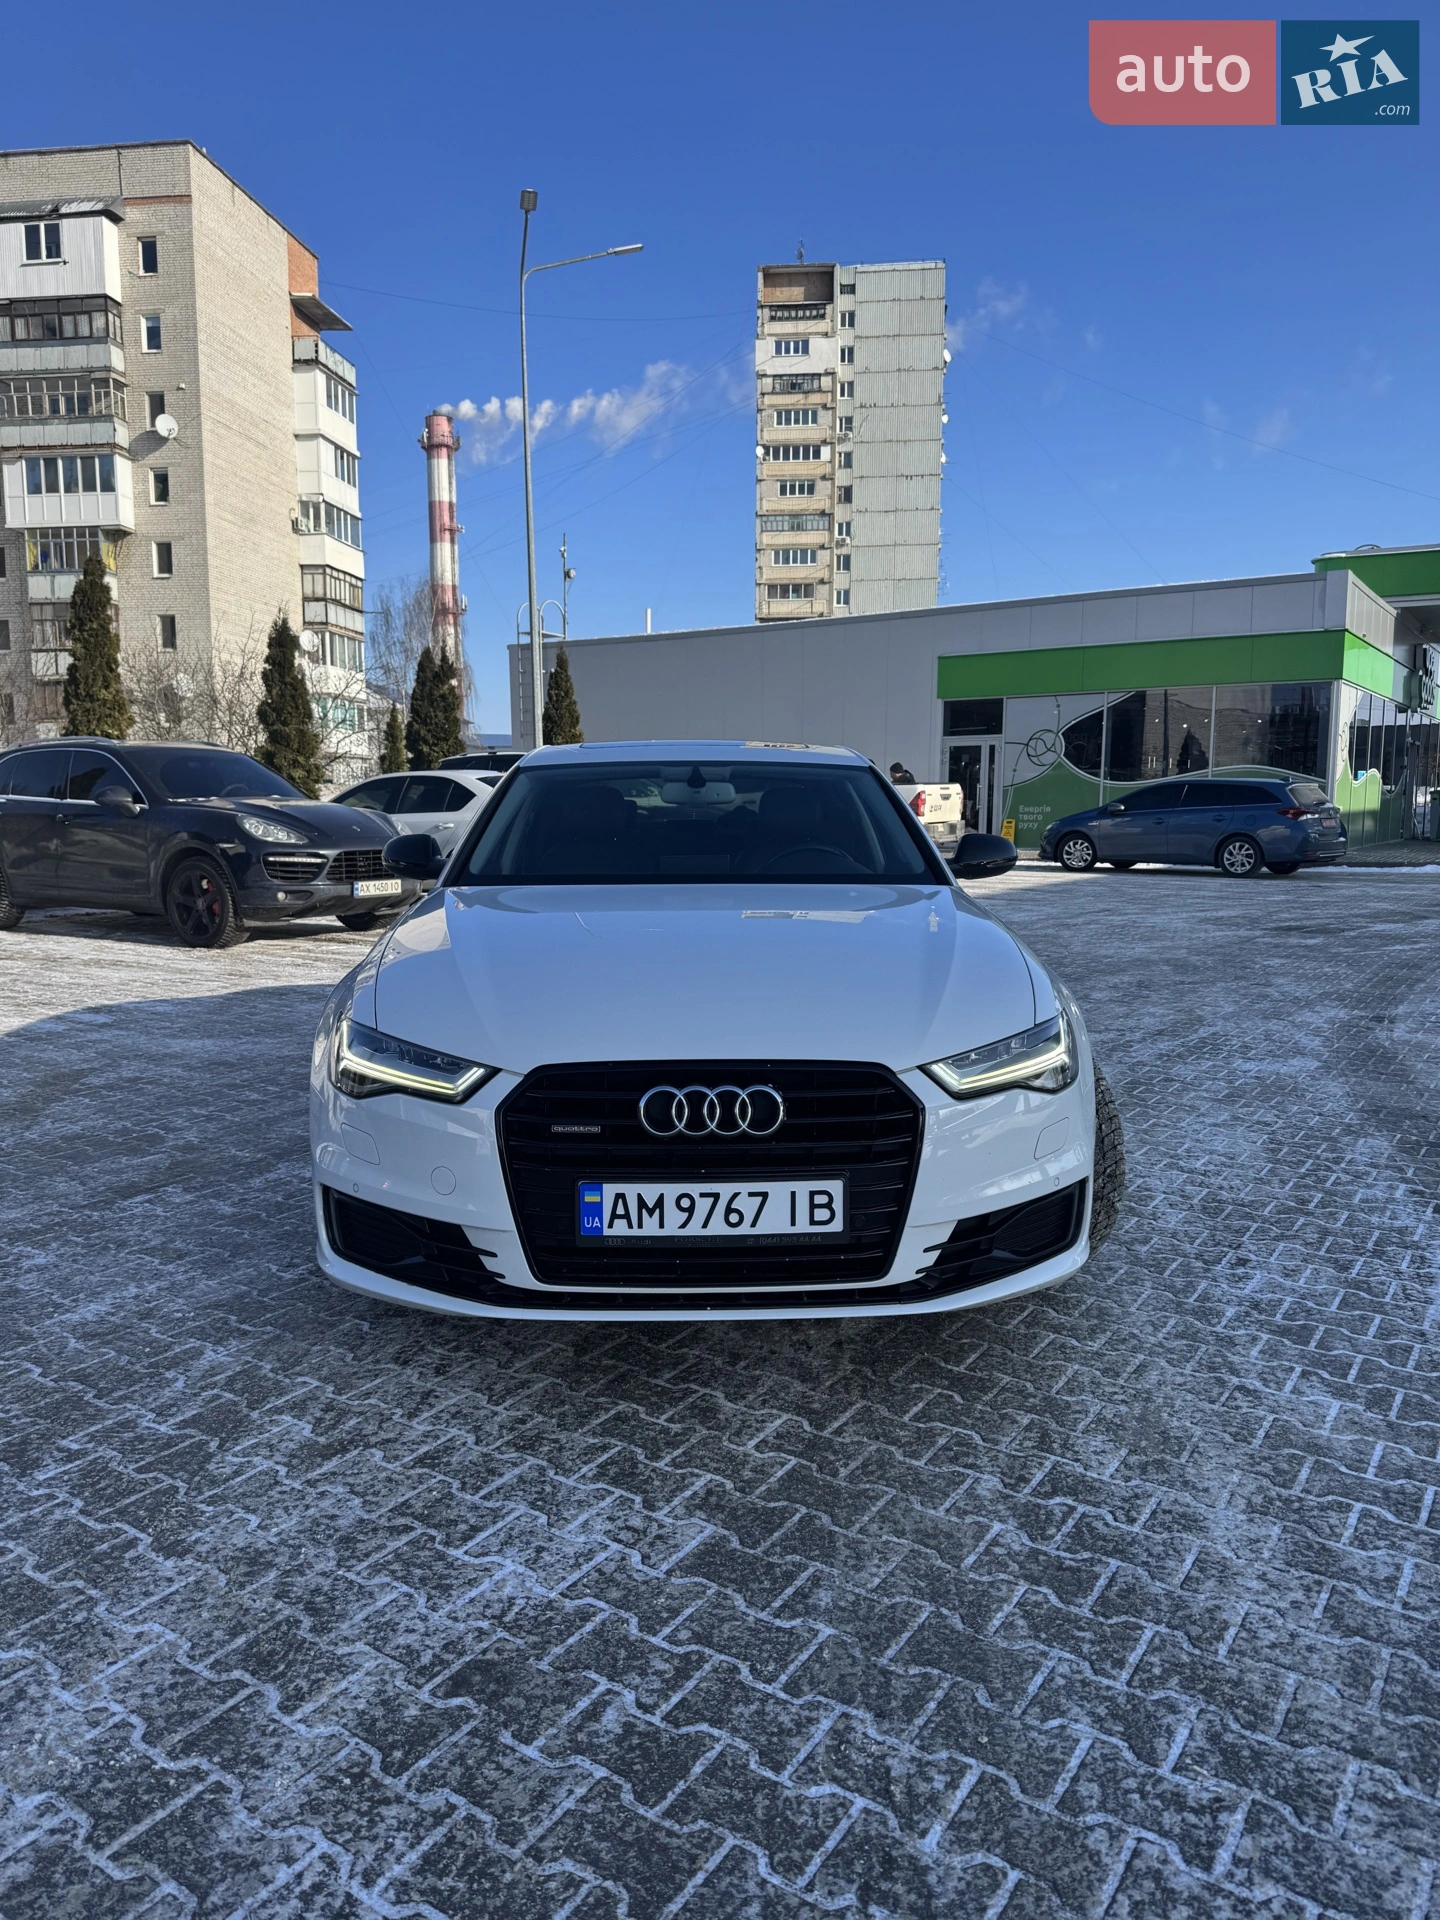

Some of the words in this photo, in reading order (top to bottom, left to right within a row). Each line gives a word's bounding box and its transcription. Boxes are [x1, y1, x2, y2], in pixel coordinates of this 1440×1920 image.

[1019, 804, 1051, 814] Енергія
[1018, 822, 1039, 830] руху
[359, 883, 371, 894] AX
[373, 882, 389, 893] 1450
[607, 1192, 665, 1230] AM
[674, 1191, 769, 1229] 9767
[790, 1189, 836, 1227] IB
[584, 1216, 601, 1228] UA
